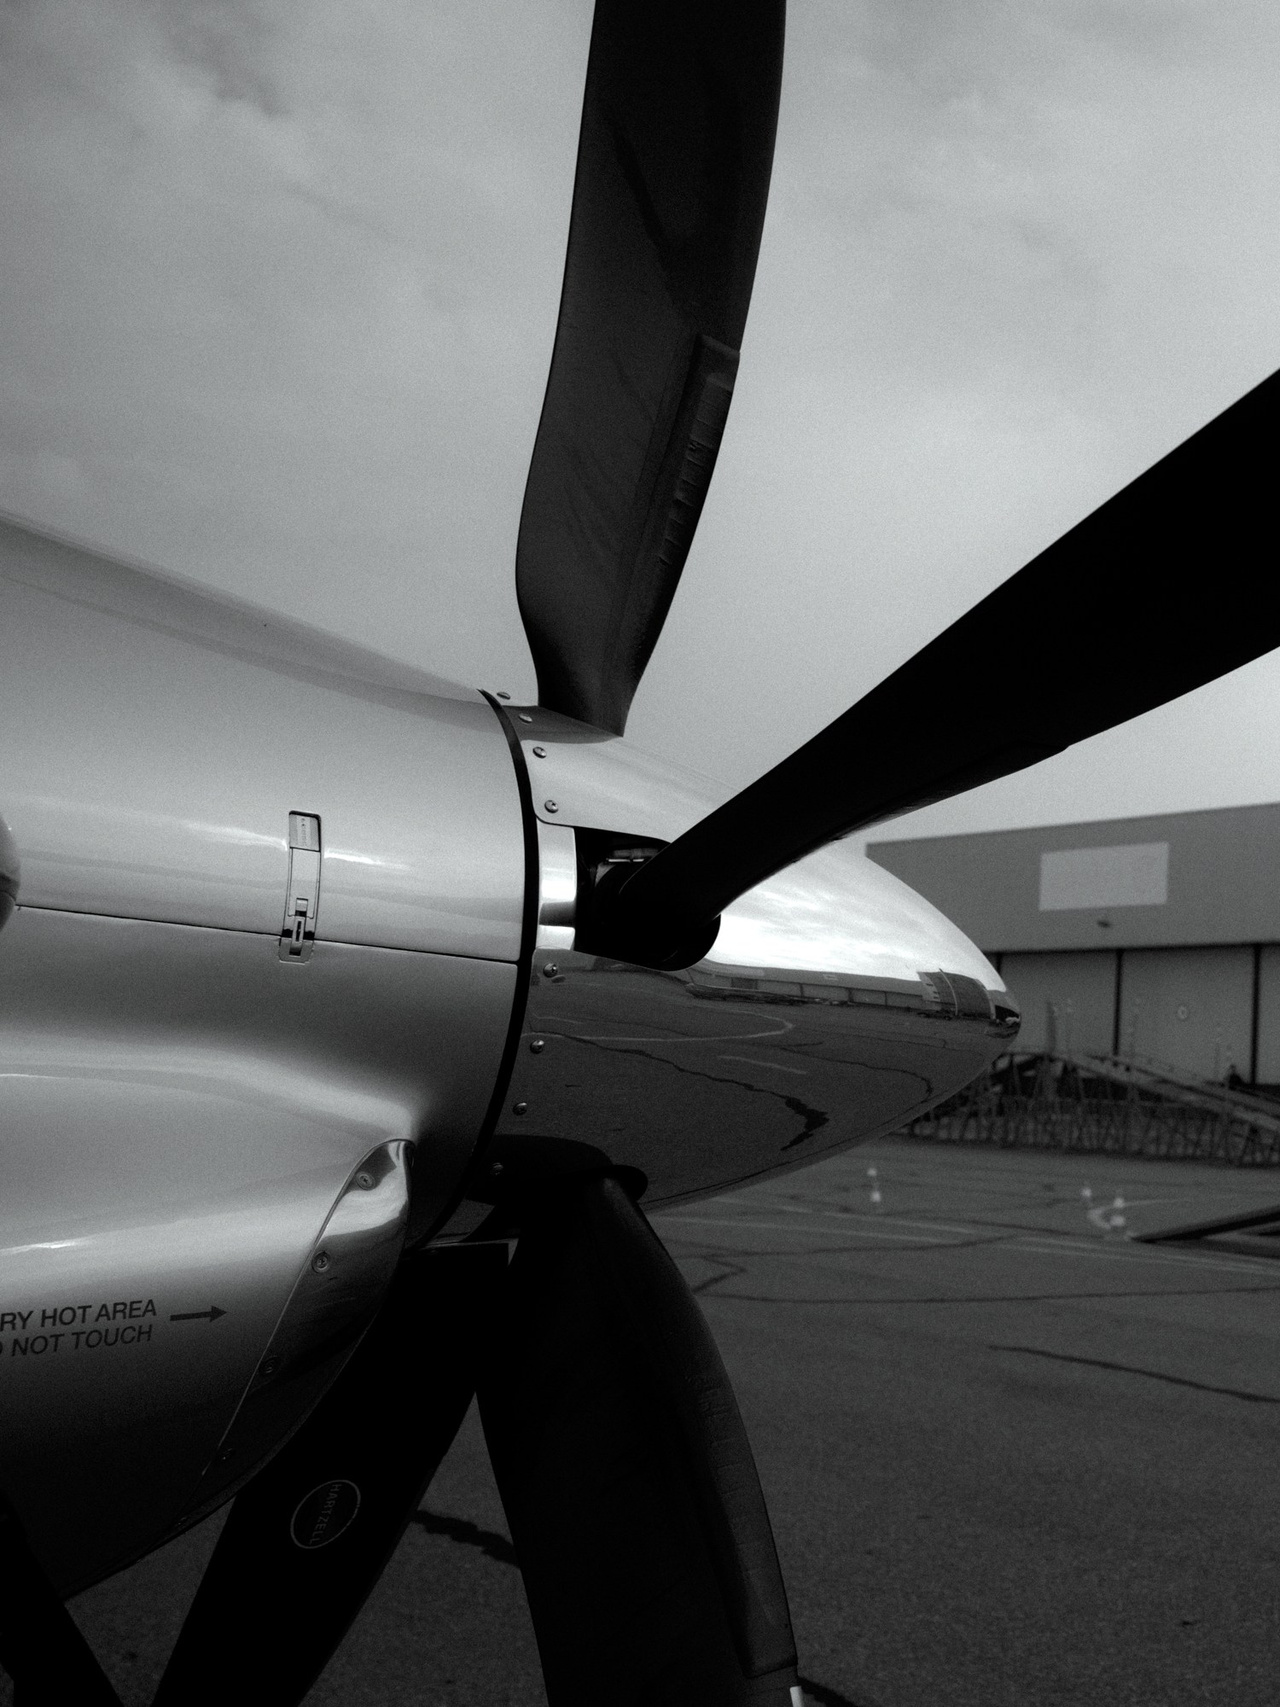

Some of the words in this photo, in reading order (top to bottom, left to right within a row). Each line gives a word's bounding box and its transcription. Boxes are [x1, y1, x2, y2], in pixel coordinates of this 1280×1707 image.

[41, 1305, 92, 1328] HOT
[95, 1299, 157, 1323] AREA
[11, 1334, 65, 1357] NOT
[71, 1324, 153, 1350] TOUCH
[308, 1483, 342, 1546] HARTZELL
